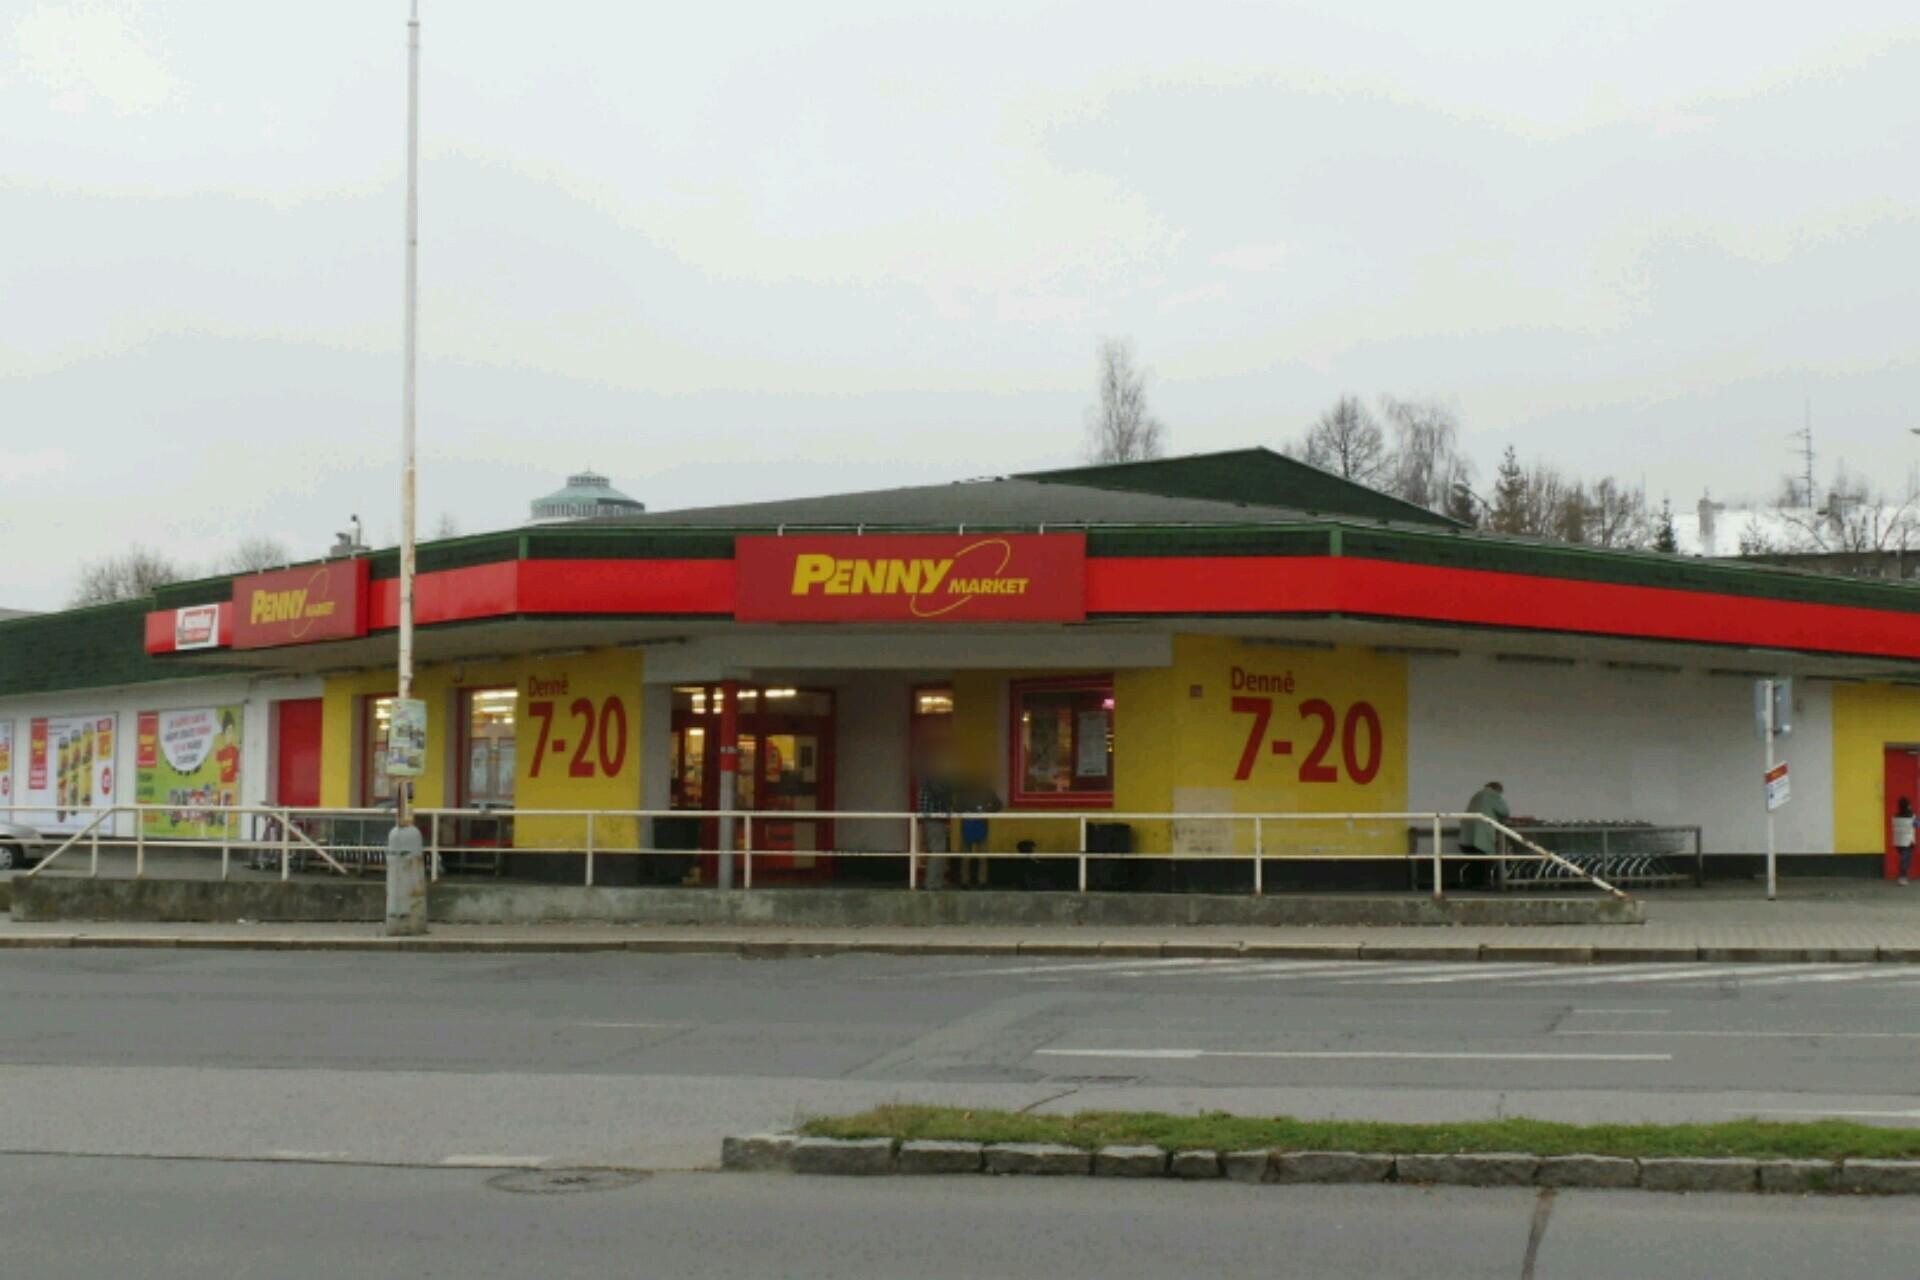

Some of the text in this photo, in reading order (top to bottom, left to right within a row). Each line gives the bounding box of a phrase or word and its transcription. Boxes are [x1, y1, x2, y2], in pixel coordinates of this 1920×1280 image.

[791, 553, 1030, 595] PENNY MARKET
[250, 588, 308, 625] PENNY
[1231, 666, 1295, 694] Denně
[528, 695, 627, 778] 7-20
[1231, 696, 1383, 785] 7-20
